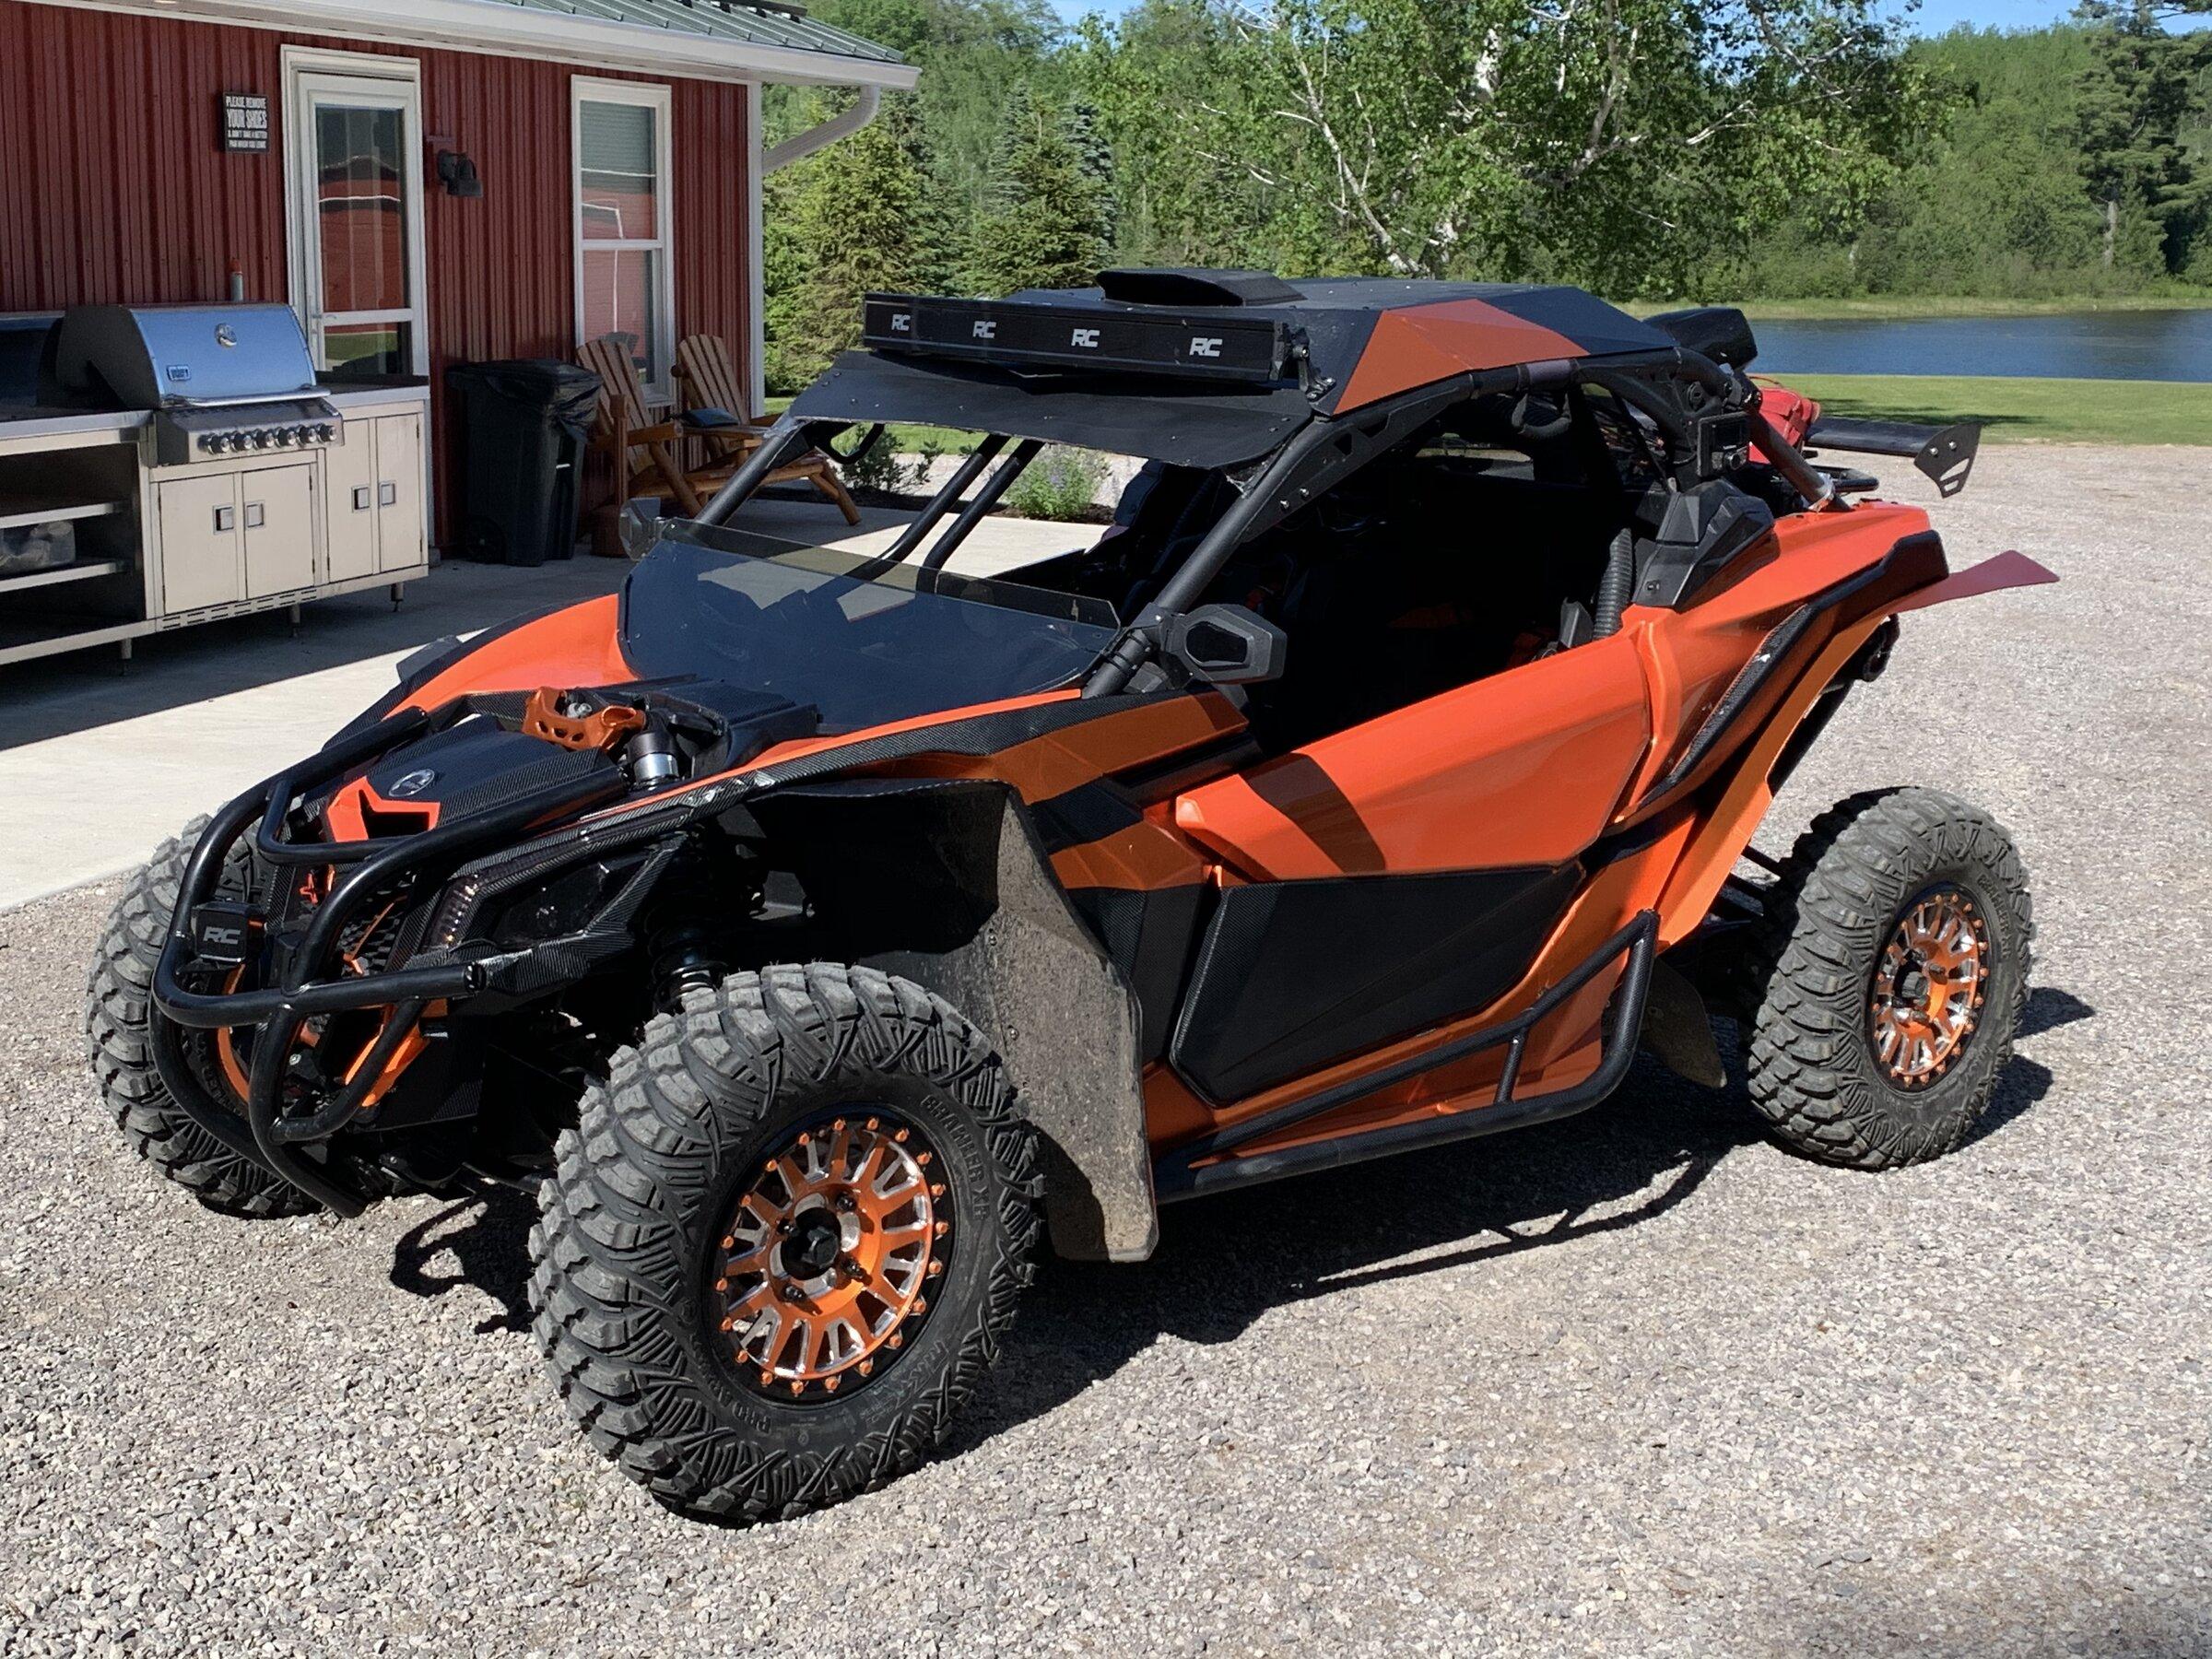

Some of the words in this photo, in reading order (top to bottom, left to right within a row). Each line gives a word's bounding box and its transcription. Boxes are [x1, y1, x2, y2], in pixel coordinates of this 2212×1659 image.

[227, 109, 246, 128] YOUR
[246, 110, 267, 129] SHOES
[891, 313, 911, 331] RC
[972, 321, 996, 338] RC
[1071, 328, 1100, 347] RC
[1189, 337, 1223, 357] RC
[204, 926, 241, 945] RC
